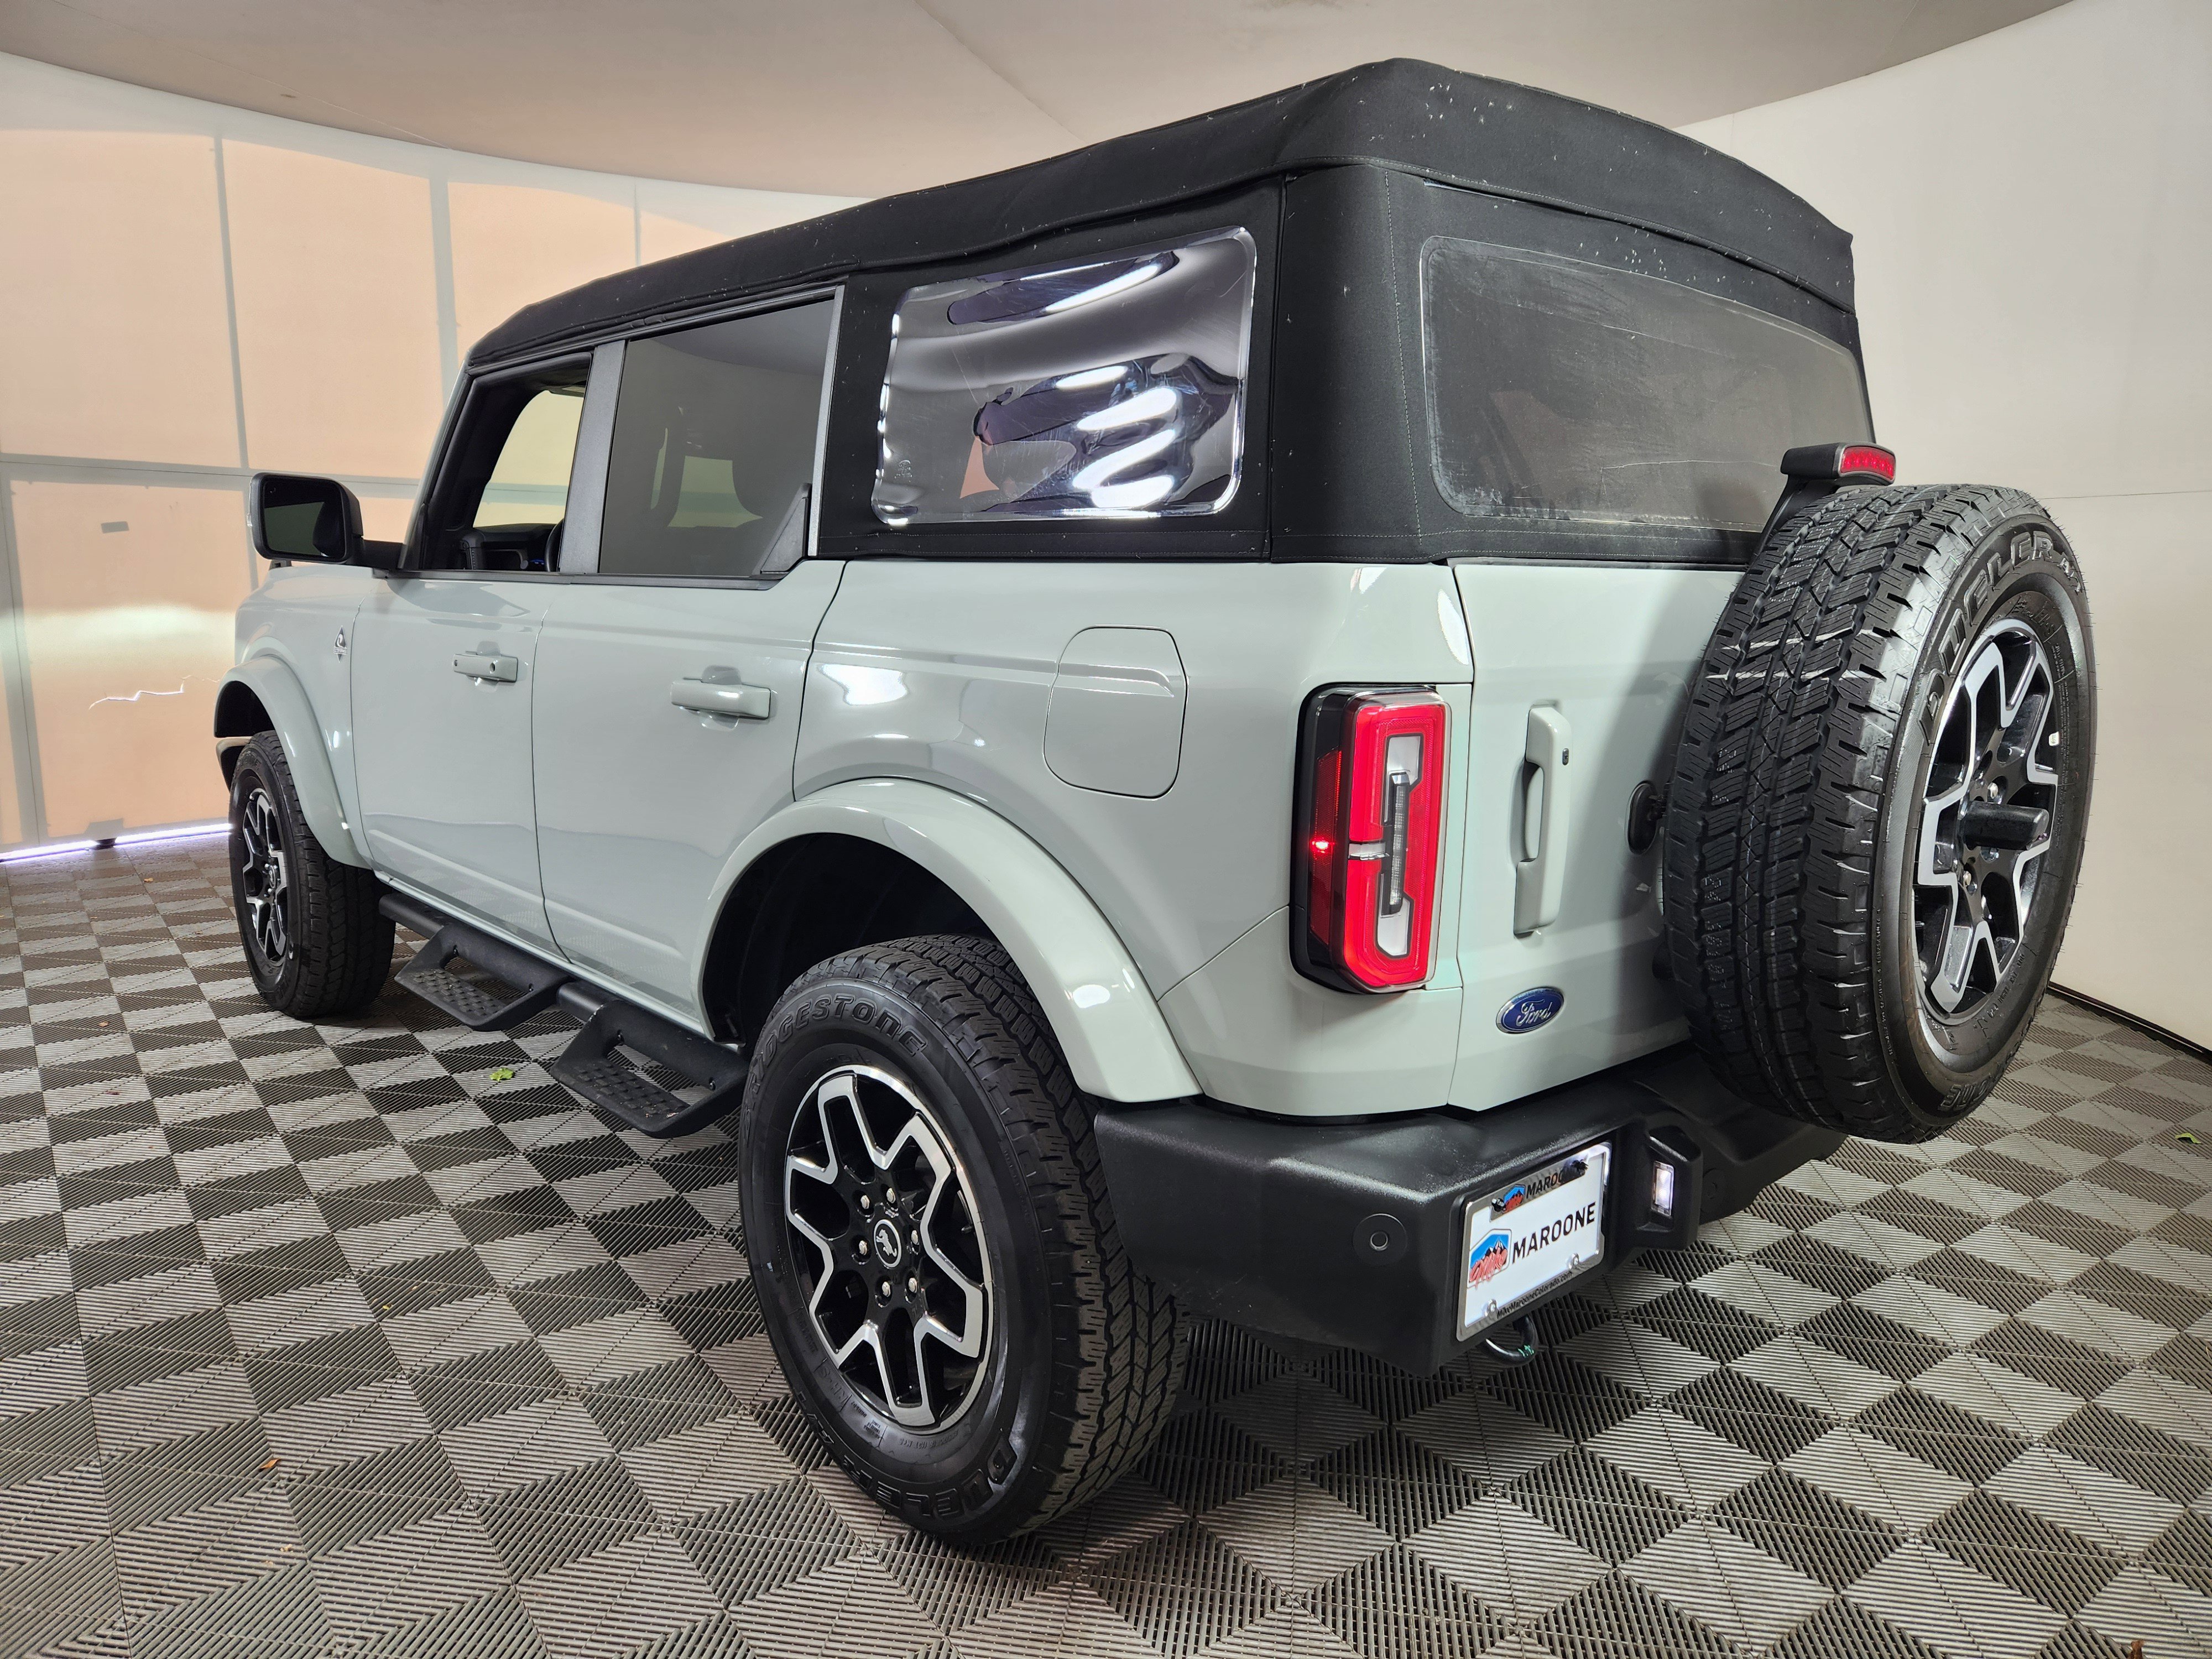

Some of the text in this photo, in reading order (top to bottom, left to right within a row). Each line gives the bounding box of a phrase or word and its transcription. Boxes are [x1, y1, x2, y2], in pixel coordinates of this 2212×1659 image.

[1917, 530, 2053, 747] DUELER
[1516, 999, 1552, 1027] Ford
[1512, 1201, 1596, 1264] MAROONE
[1497, 1271, 1573, 1319] MikeMarooneColorado.com
